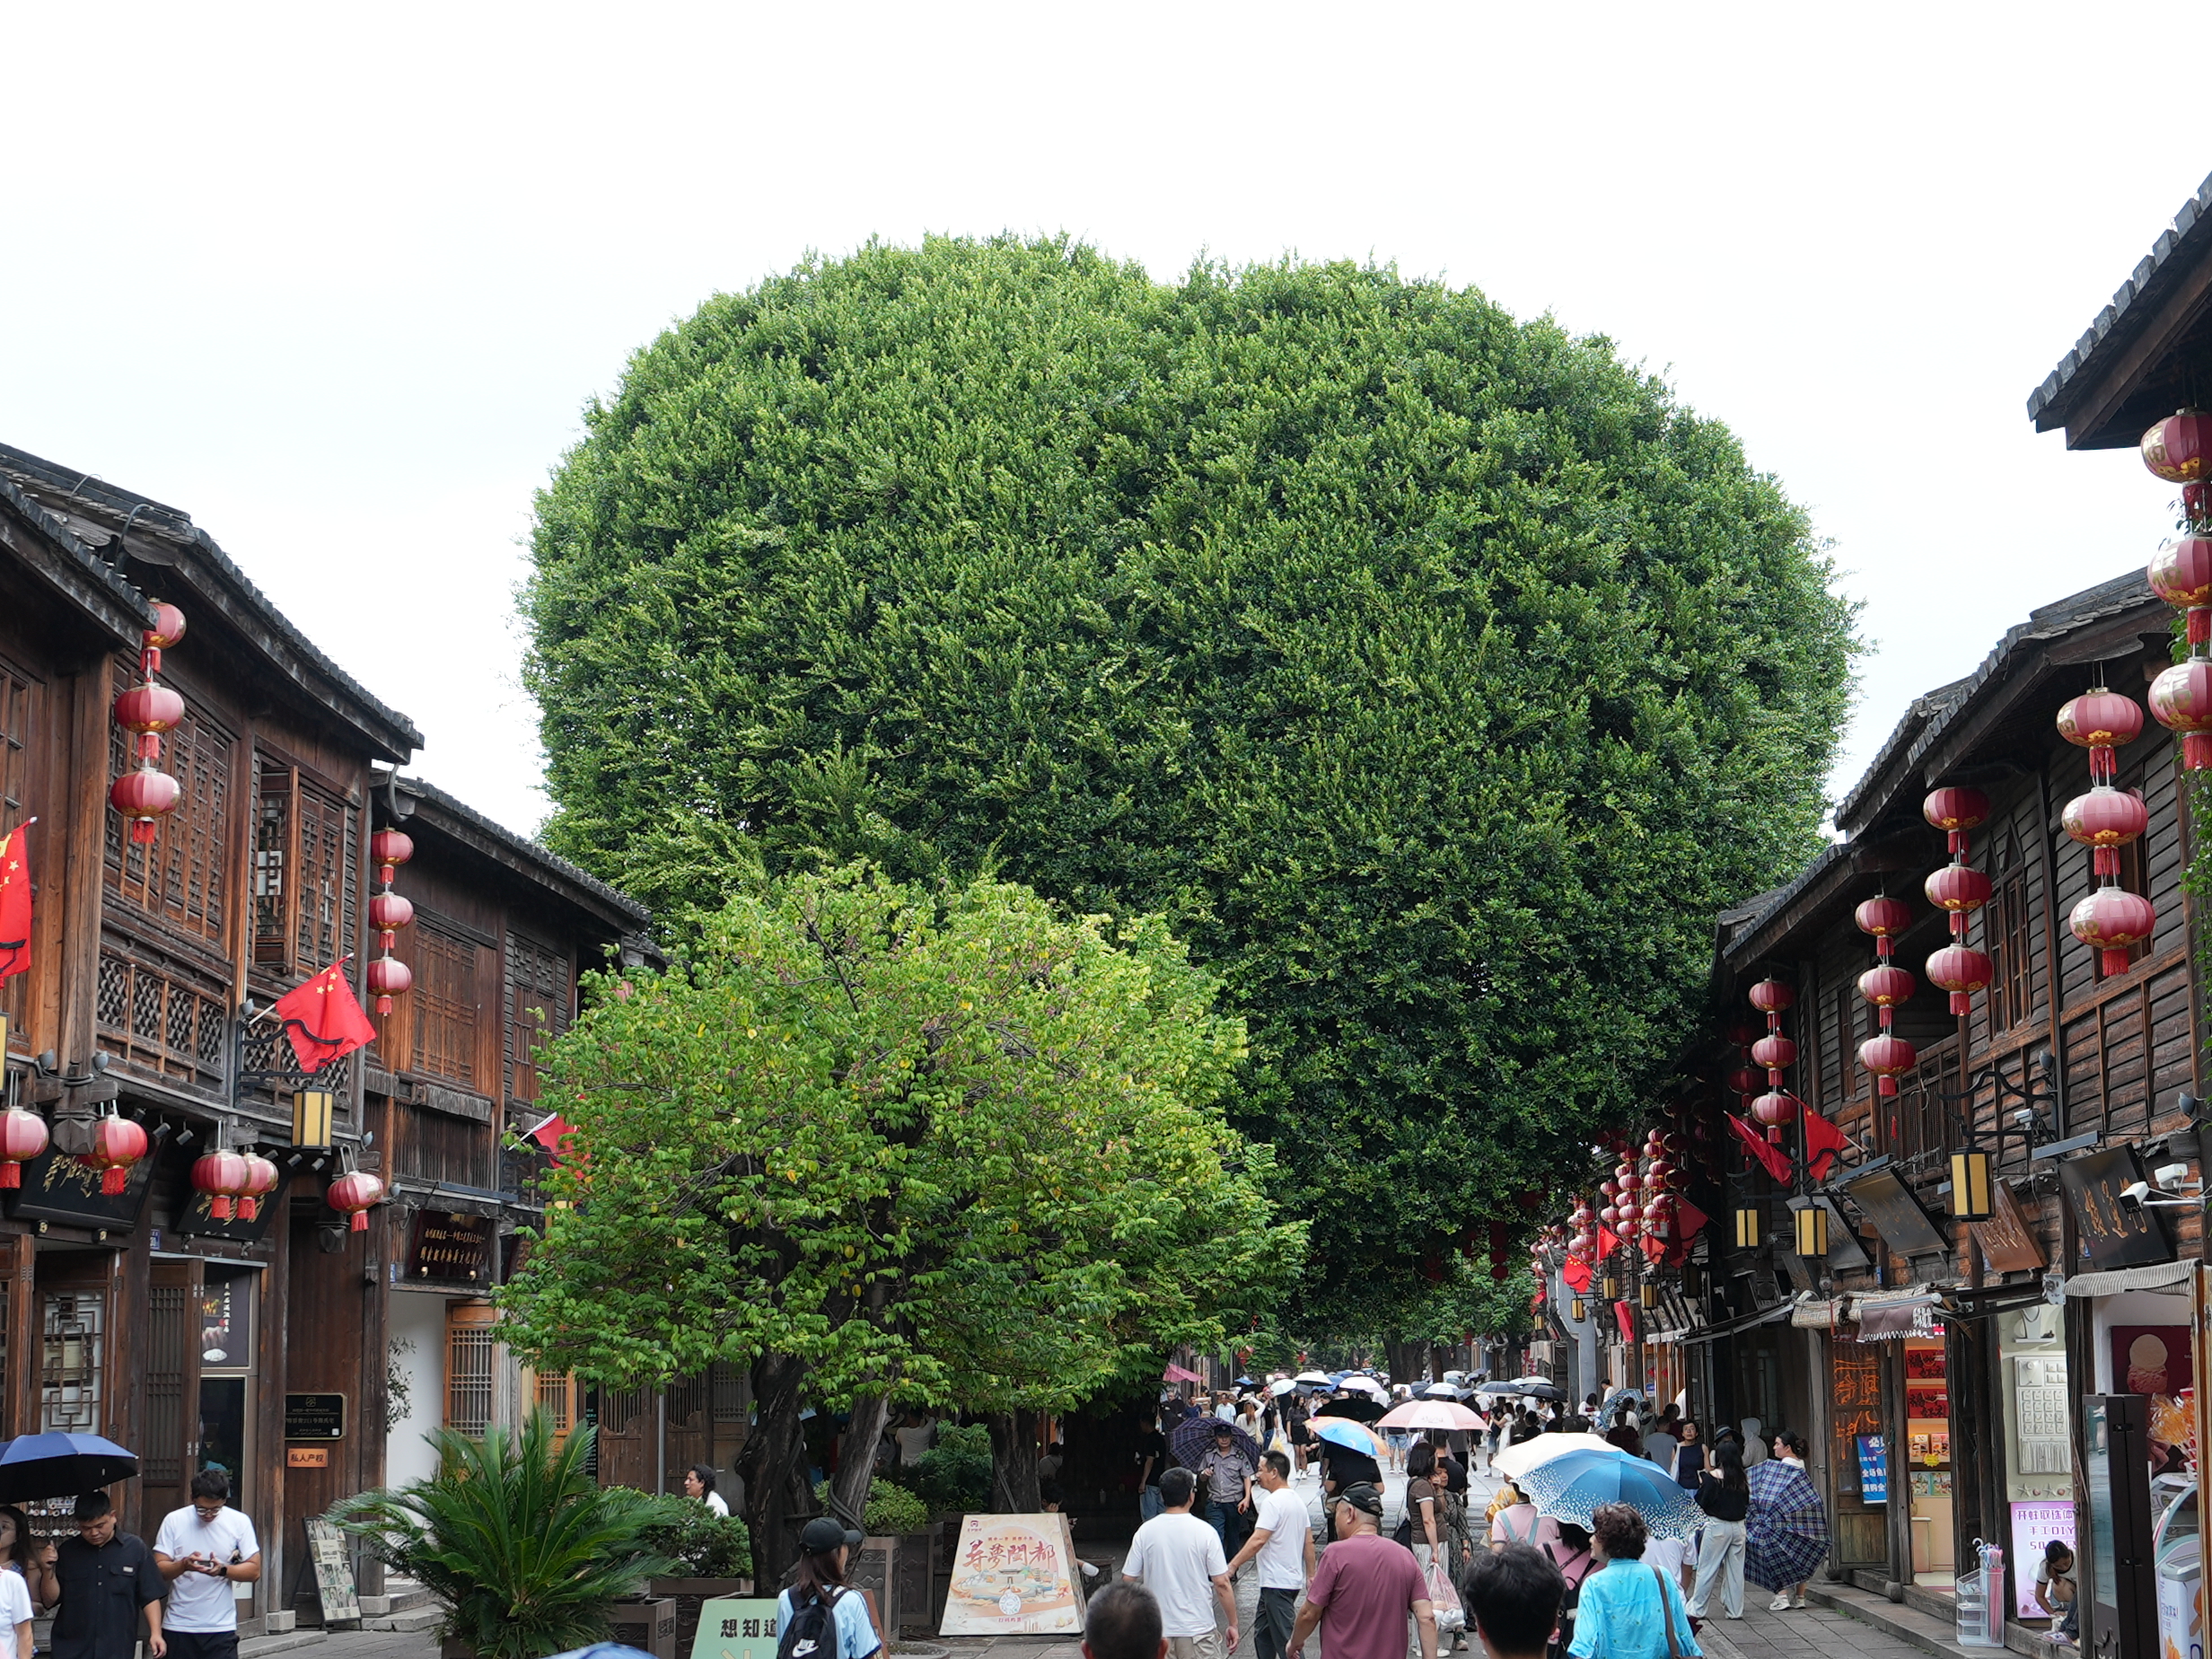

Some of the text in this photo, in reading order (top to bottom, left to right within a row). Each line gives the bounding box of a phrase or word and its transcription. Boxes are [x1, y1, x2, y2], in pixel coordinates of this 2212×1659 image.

[290, 1453, 325, 1462] 私人产权
[2028, 1525, 2076, 1536] 手工DIY
[719, 1618, 777, 1638] 想知道
[798, 1638, 816, 1649] NIKE
